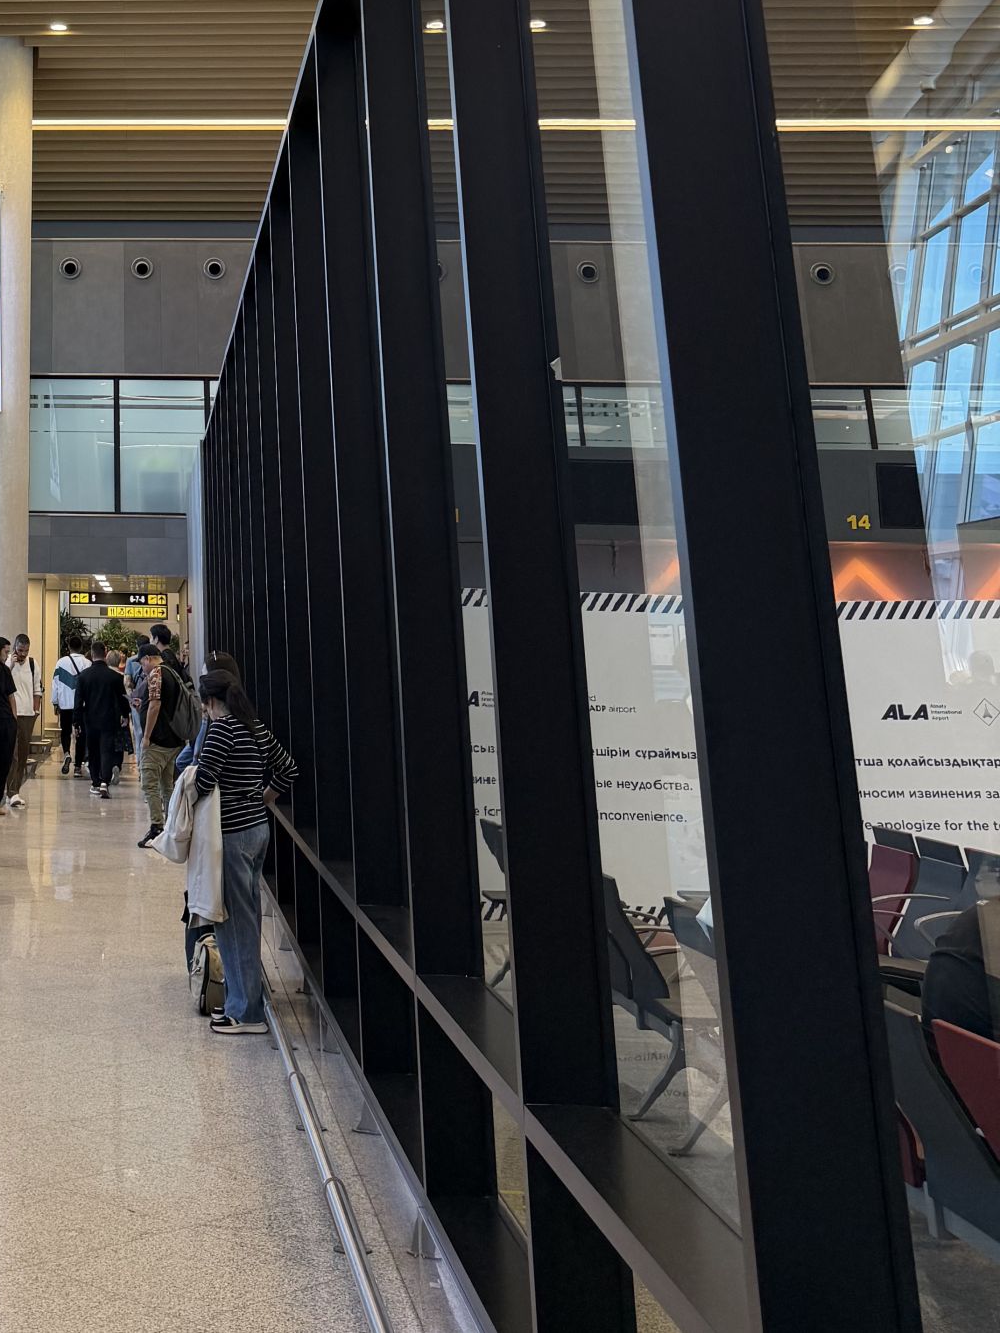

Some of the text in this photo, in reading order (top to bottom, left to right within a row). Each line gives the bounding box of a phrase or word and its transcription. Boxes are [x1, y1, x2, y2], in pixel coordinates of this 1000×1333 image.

[847, 515, 870, 530] 14
[91, 594, 96, 602] 5
[608, 706, 637, 714] airport
[881, 704, 929, 720] ALA
[616, 779, 693, 791] неудобства.
[909, 790, 982, 799] извинения
[985, 790, 1000, 799] за
[876, 819, 941, 833] apologize
[944, 820, 963, 831] for
[967, 820, 989, 831] the
